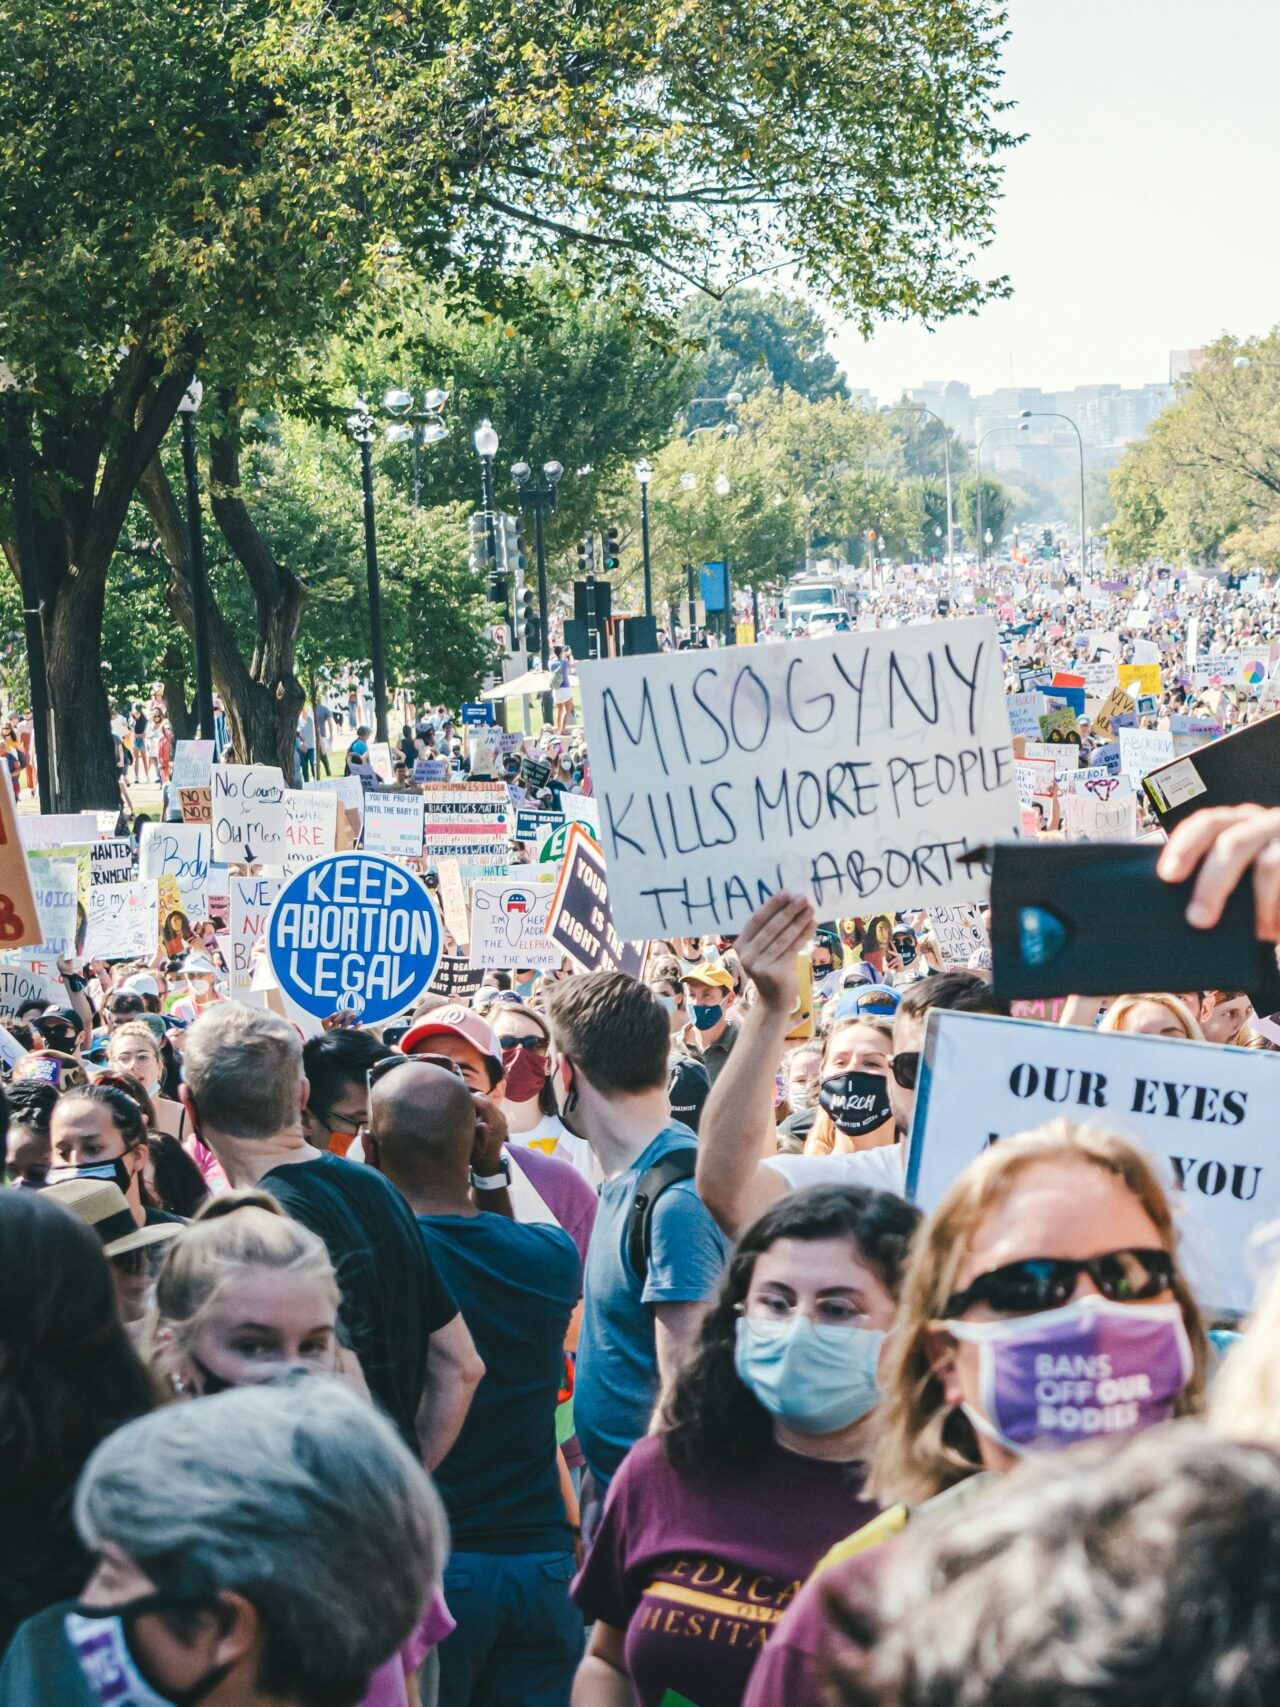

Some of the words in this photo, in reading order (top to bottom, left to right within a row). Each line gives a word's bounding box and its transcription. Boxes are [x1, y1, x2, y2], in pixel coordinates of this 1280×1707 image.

[601, 641, 983, 776] MISOGYNY
[215, 771, 238, 799] No
[242, 772, 284, 801] Country
[1087, 769, 1105, 780] NOT
[181, 791, 200, 802] NO
[428, 803, 452, 813] BLACK
[452, 803, 477, 814] LIVES
[477, 803, 507, 814] MATTER
[605, 782, 737, 860] KILLS
[755, 760, 881, 841] MORE
[886, 746, 1015, 819] PEOPLE
[183, 807, 201, 818] NO
[519, 813, 537, 822] YOUR
[538, 814, 564, 823] REASON
[216, 818, 242, 845] Old
[246, 822, 281, 843] Men
[285, 825, 325, 846] ARE
[162, 832, 208, 888] Body
[484, 865, 509, 877] HATE
[306, 859, 410, 906] KEEP
[577, 857, 608, 905] YOUR
[640, 864, 787, 930] THAN
[810, 827, 1000, 908] ABORTI
[527, 914, 549, 924] HER
[591, 905, 605, 932] IS
[935, 905, 967, 923] BUT
[276, 902, 433, 956] ABORTION
[494, 927, 505, 935] TO
[524, 926, 545, 936] ADDR
[559, 908, 601, 958] RIGHT
[935, 925, 970, 944] LOOK
[484, 940, 504, 948] THE
[519, 940, 556, 950] ELEPHAN
[480, 955, 495, 964] IN
[504, 955, 520, 964] THE
[526, 955, 555, 964] WOMB
[0, 972, 42, 1001] TION
[289, 950, 416, 1001] LEGAL
[440, 972, 450, 982] IS
[453, 974, 469, 983] THE
[451, 983, 481, 994] REASON
[1008, 1062, 1109, 1108] OUR
[1130, 1077, 1249, 1127] EYES
[1169, 1156, 1264, 1201] YOU
[1034, 1353, 1113, 1380] BANS
[1034, 1379, 1094, 1405] OFF
[1095, 1373, 1152, 1405] OUR
[1036, 1400, 1140, 1434] BODIES
[670, 1559, 801, 1605] EDICA
[639, 1605, 769, 1649] HESITA
